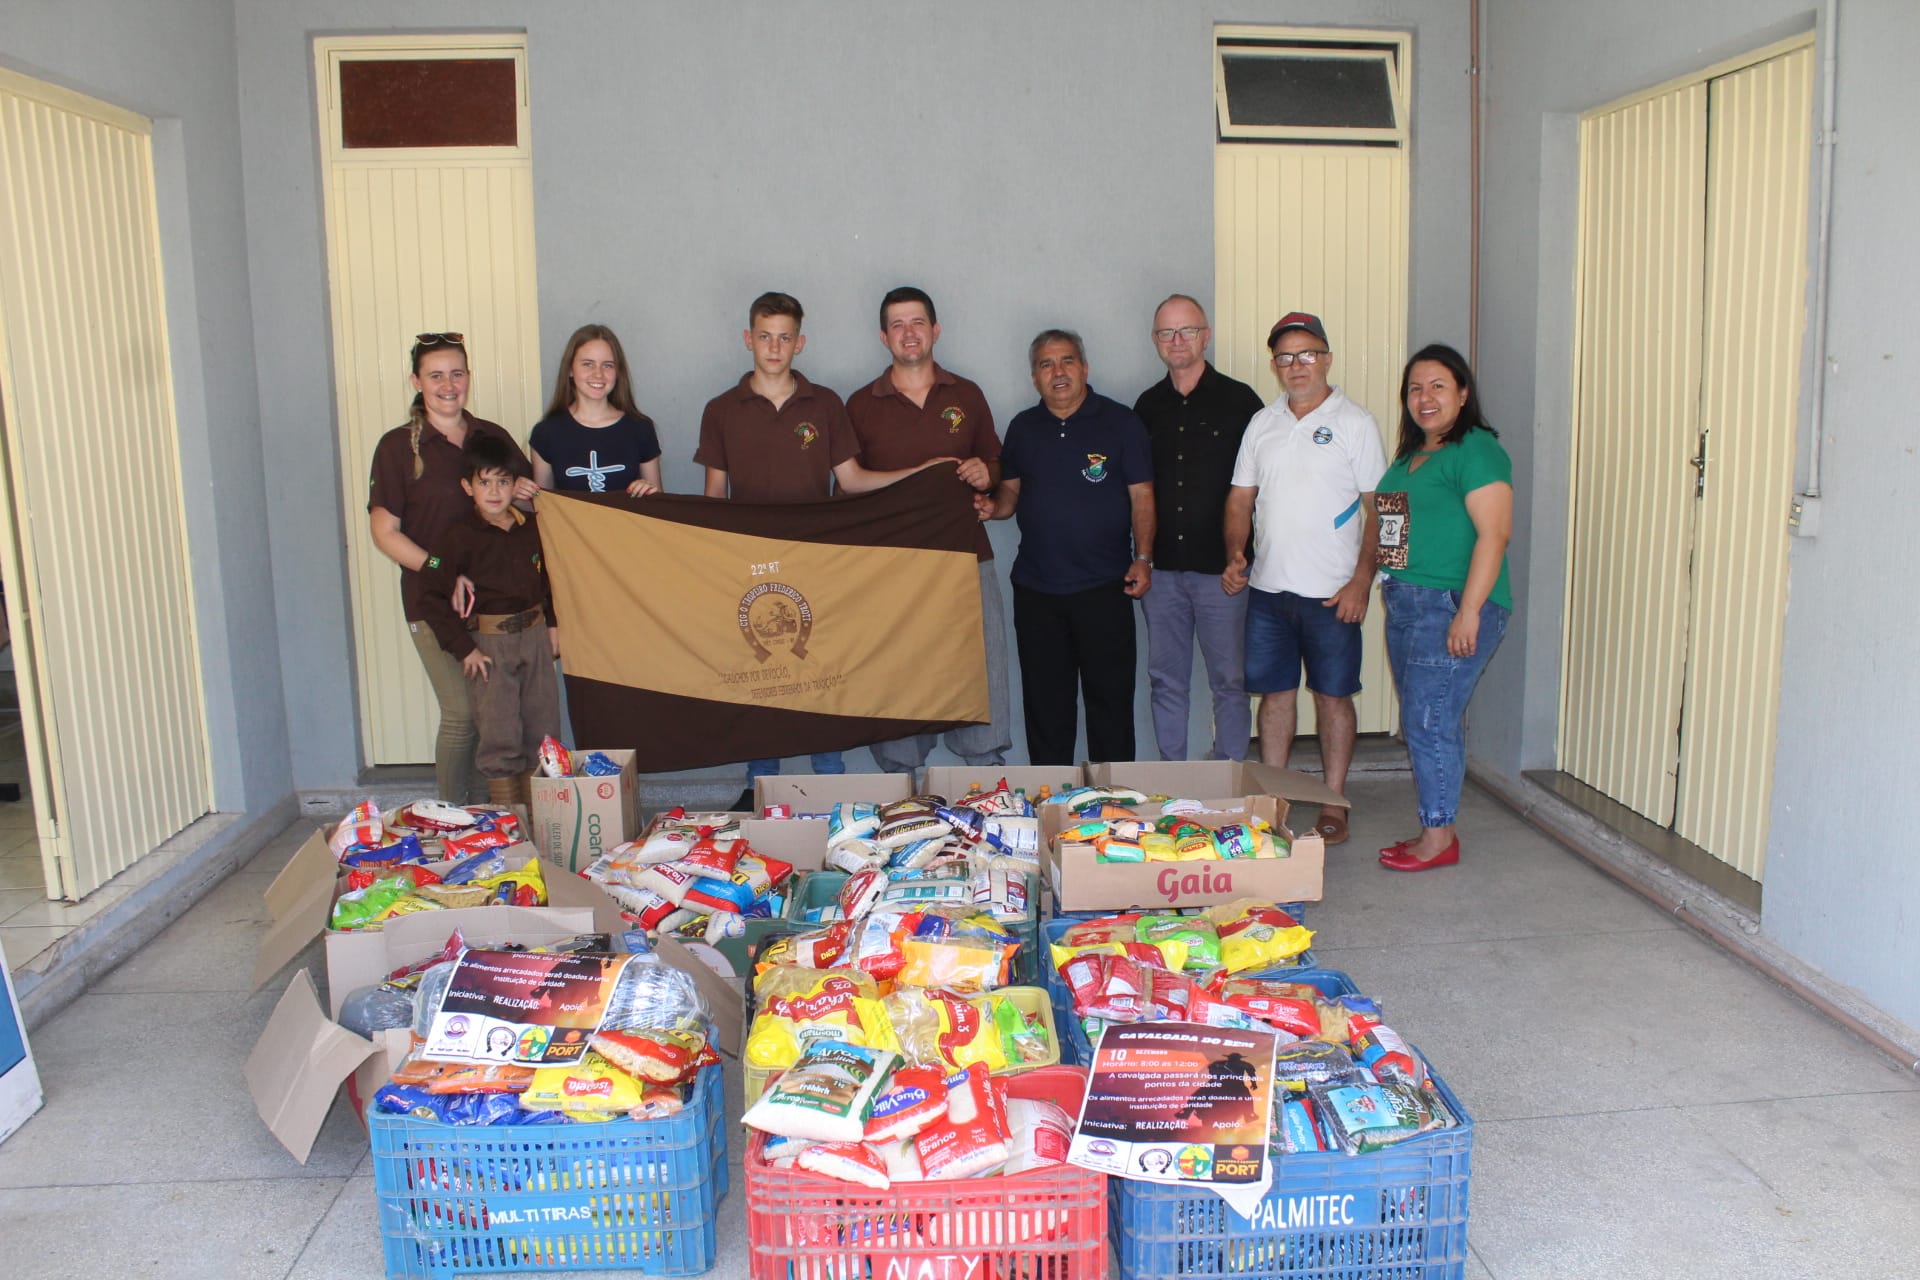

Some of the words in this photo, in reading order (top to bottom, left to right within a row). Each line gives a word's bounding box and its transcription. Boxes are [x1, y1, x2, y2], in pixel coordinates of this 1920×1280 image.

[768, 561, 780, 574] RT
[741, 584, 769, 607] TROPEIRO
[770, 583, 803, 603] FREDERICO
[739, 614, 749, 627] CTG
[1157, 865, 1233, 903] Gaia
[469, 961, 502, 974] alimentos
[503, 967, 544, 979] arrecadados
[563, 971, 588, 982] doados
[493, 974, 527, 986] instituição
[528, 978, 537, 987] de
[537, 978, 566, 988] caridade
[448, 989, 487, 1002] Iniciativa:
[493, 995, 540, 1011] REALIZAÇÃO:
[1119, 1032, 1199, 1042] CAVALGADA
[1201, 1036, 1222, 1045] DO
[546, 1045, 582, 1056] PORT
[1110, 1049, 1127, 1061] 10
[1174, 1060, 1199, 1068] 12:00
[1117, 1072, 1162, 1080] cavalgada
[1163, 1071, 1199, 1080] passará
[1219, 1073, 1264, 1082] principais
[1144, 1081, 1177, 1089] pontos
[1178, 1080, 1190, 1088] da
[1191, 1080, 1223, 1088] cidade
[1099, 1094, 1136, 1102] alimentos
[1137, 1094, 1184, 1102] arrecadados
[1129, 1102, 1168, 1110] instituição
[1180, 1101, 1213, 1109] caridade
[1084, 1120, 1128, 1130] Iniciativa:
[1135, 1120, 1189, 1131] REALIZAÇÃO:
[919, 1131, 957, 1156] Branco
[1215, 1163, 1259, 1176] PORT
[1251, 1194, 1354, 1231] PALMITEC
[885, 1254, 980, 1280] NATY
